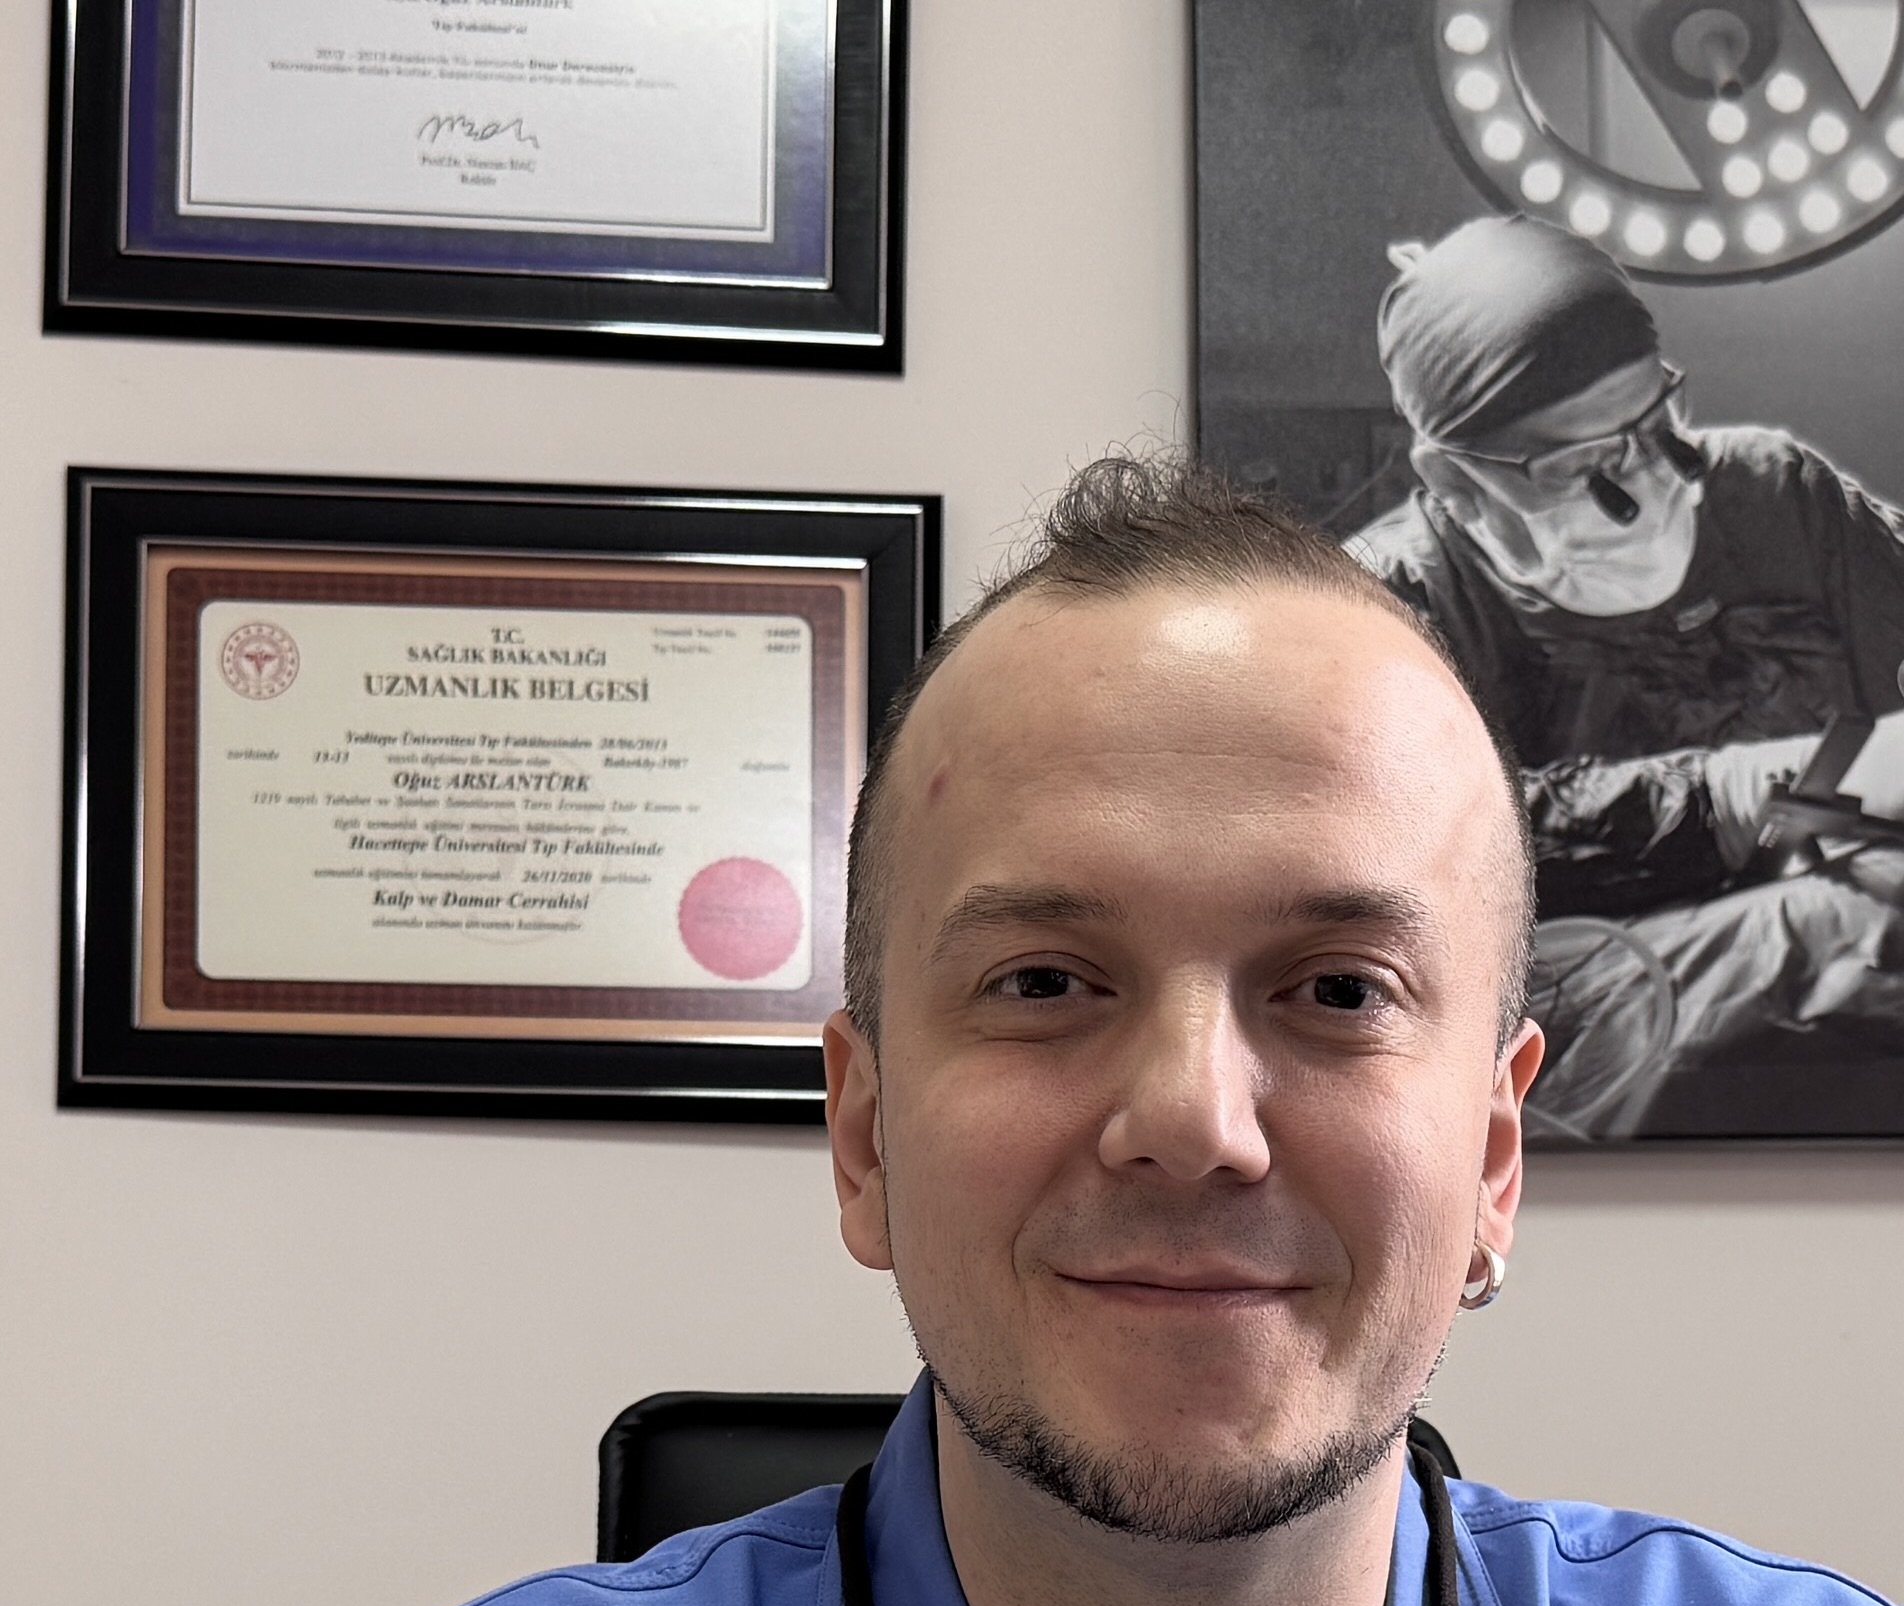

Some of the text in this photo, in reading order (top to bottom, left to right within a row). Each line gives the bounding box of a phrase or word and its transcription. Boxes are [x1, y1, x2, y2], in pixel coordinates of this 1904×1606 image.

[407, 645, 607, 667] SAĞLIK BAKANLIĞI
[364, 673, 650, 702] UZMANLIK BELGESİ
[393, 771, 591, 793] Oğuz ARSLANTÜRK
[350, 834, 666, 857] Hacettepe Üniversitesi Tıp Fakültesinde
[373, 889, 590, 911] Kalp ve Damar Cerrahisi
